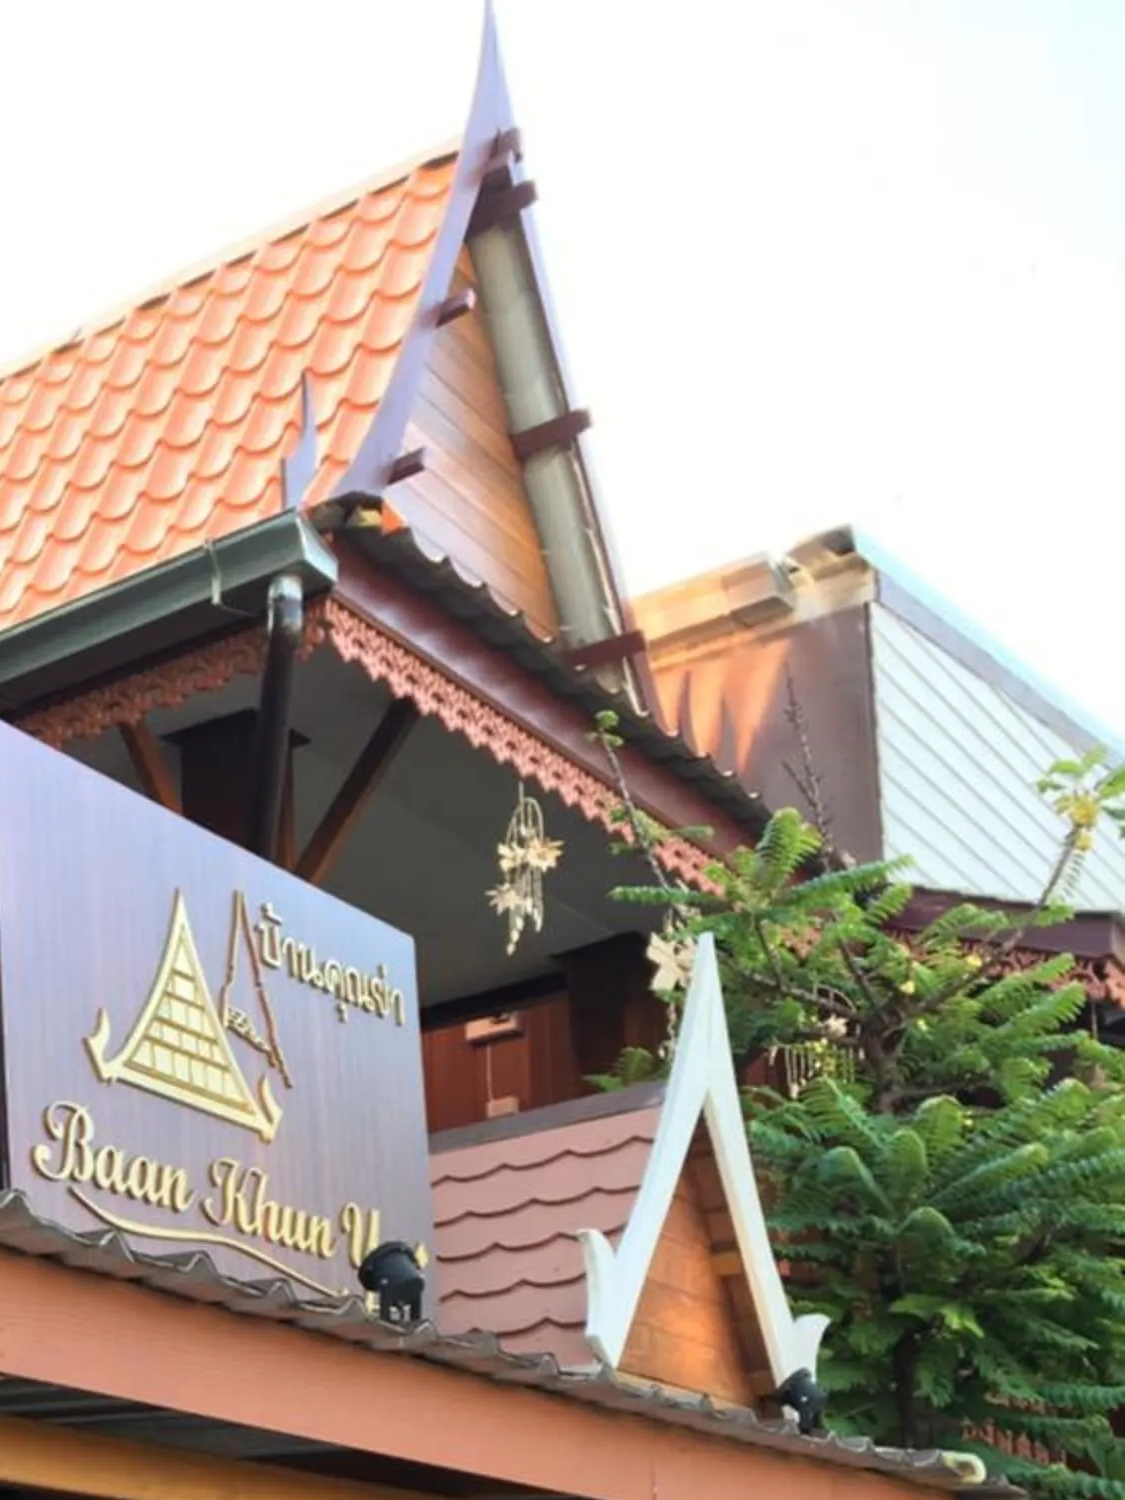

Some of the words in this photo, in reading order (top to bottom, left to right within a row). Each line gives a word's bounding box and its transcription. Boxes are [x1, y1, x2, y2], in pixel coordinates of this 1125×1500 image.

[254, 902, 406, 1026] บ้านคุณย่า
[31, 1100, 195, 1212] Baan
[201, 1157, 339, 1258] Khun
[339, 1201, 430, 1310] Y
